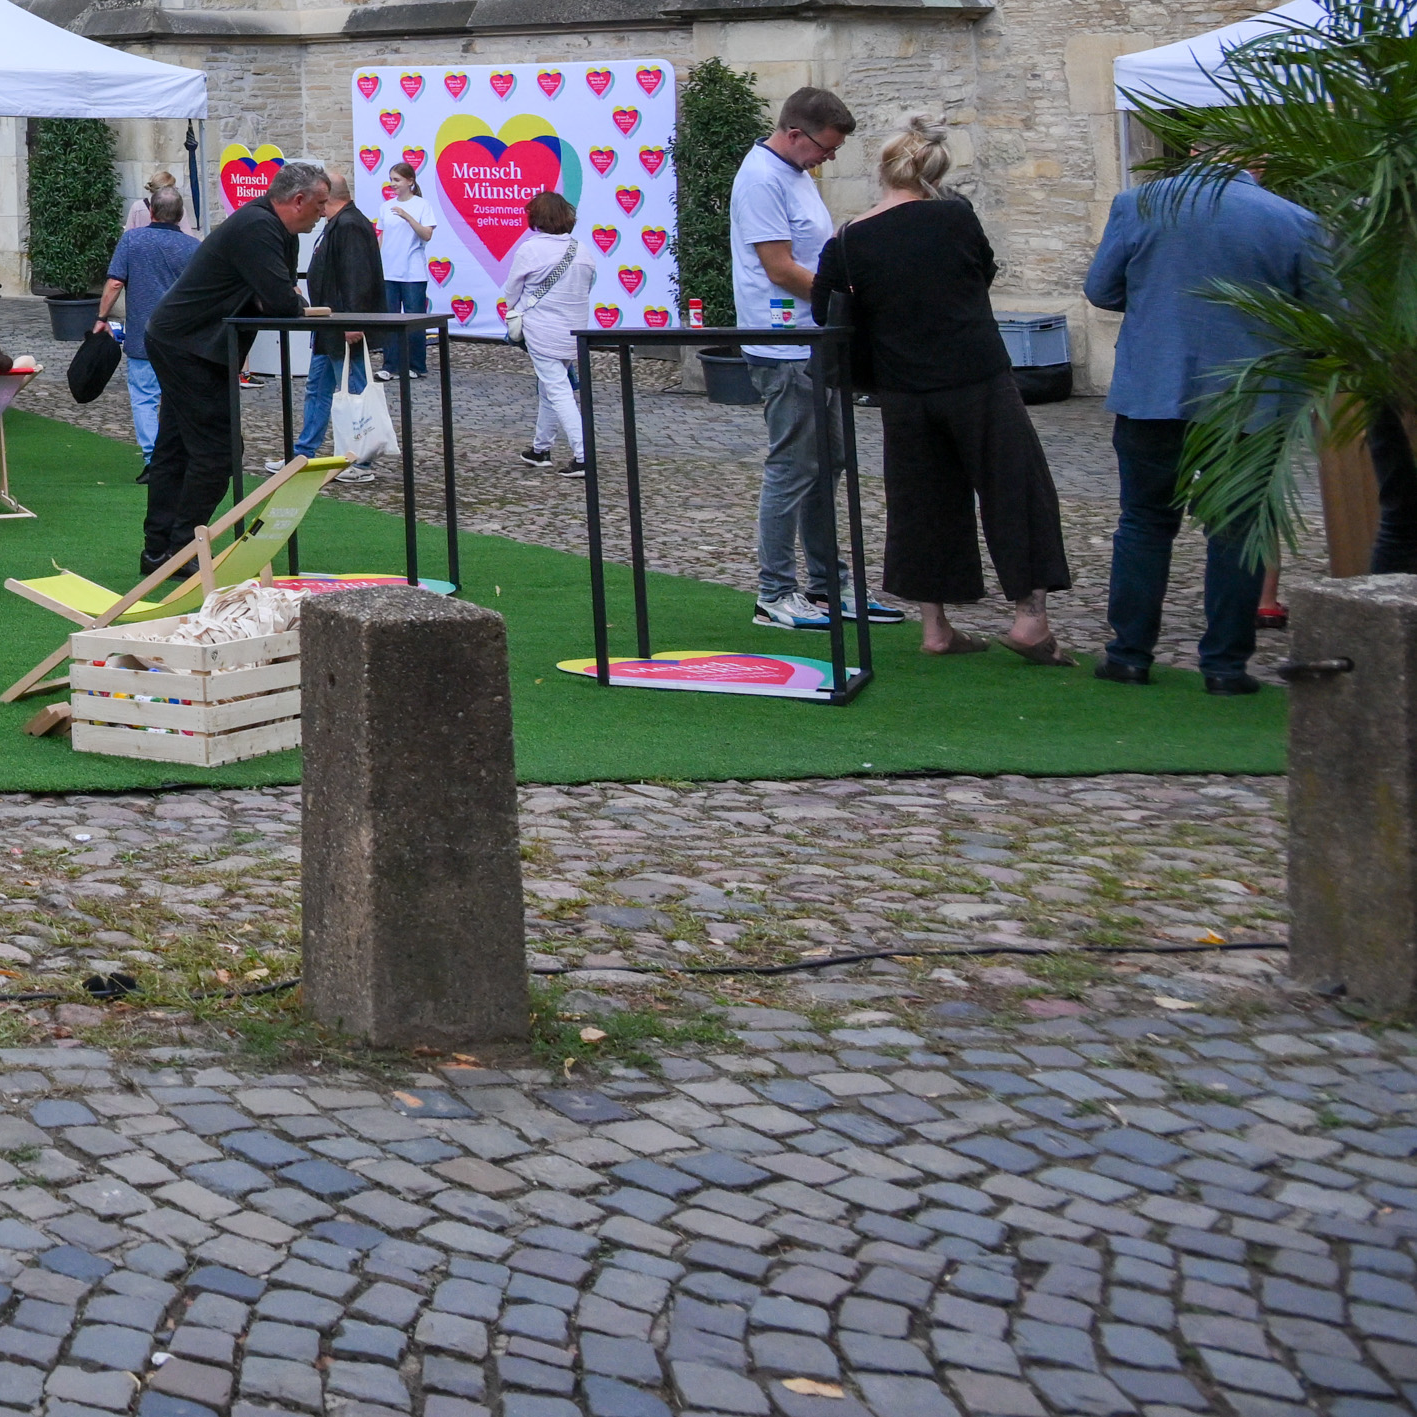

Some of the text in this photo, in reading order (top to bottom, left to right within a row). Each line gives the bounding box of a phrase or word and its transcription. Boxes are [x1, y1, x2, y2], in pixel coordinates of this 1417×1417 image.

[452, 161, 522, 179] Mensch
[231, 173, 268, 185] Mensch
[463, 182, 545, 199] Münster!
[473, 205, 525, 214] Zusammen
[477, 217, 522, 227] geht was!
